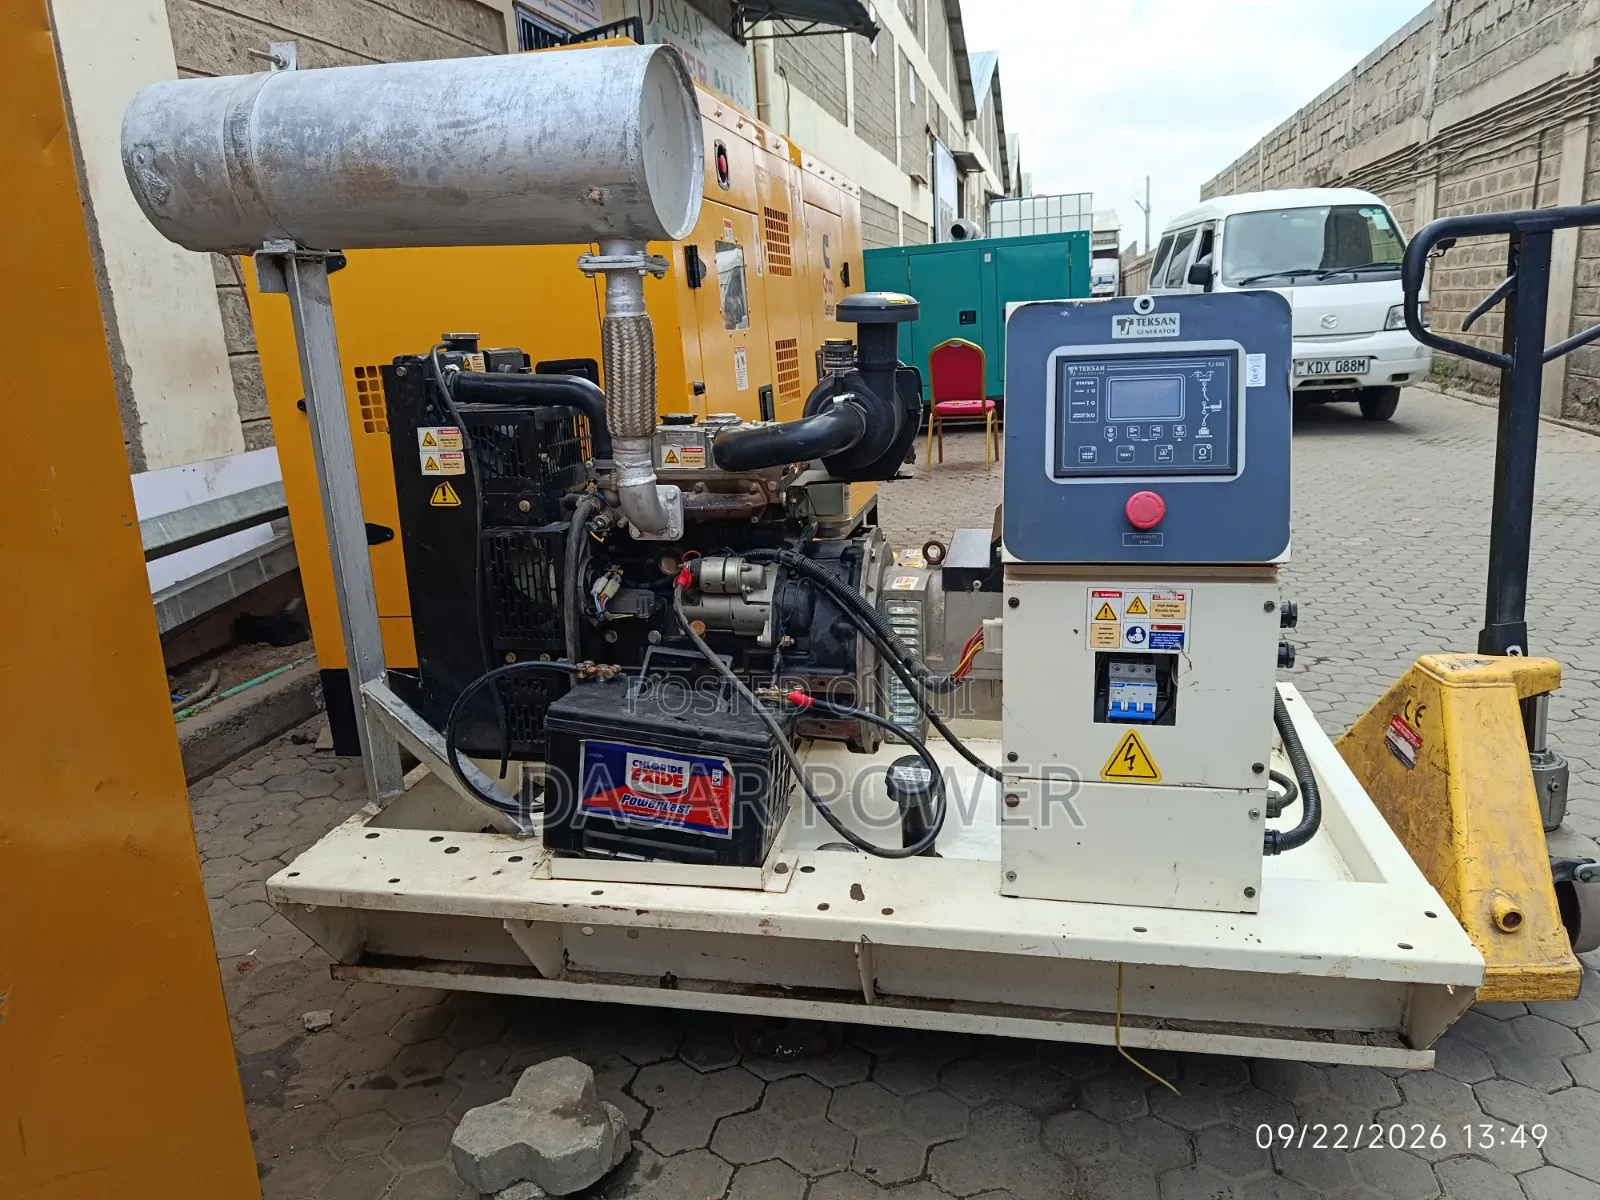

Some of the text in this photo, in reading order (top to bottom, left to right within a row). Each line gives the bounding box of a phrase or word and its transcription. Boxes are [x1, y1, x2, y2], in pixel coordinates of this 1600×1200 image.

[1136, 316, 1176, 327] TEKSAN
[1307, 361, 1331, 374] KDX
[632, 759, 684, 774] CHLORIDE
[631, 767, 684, 788] EXIDE
